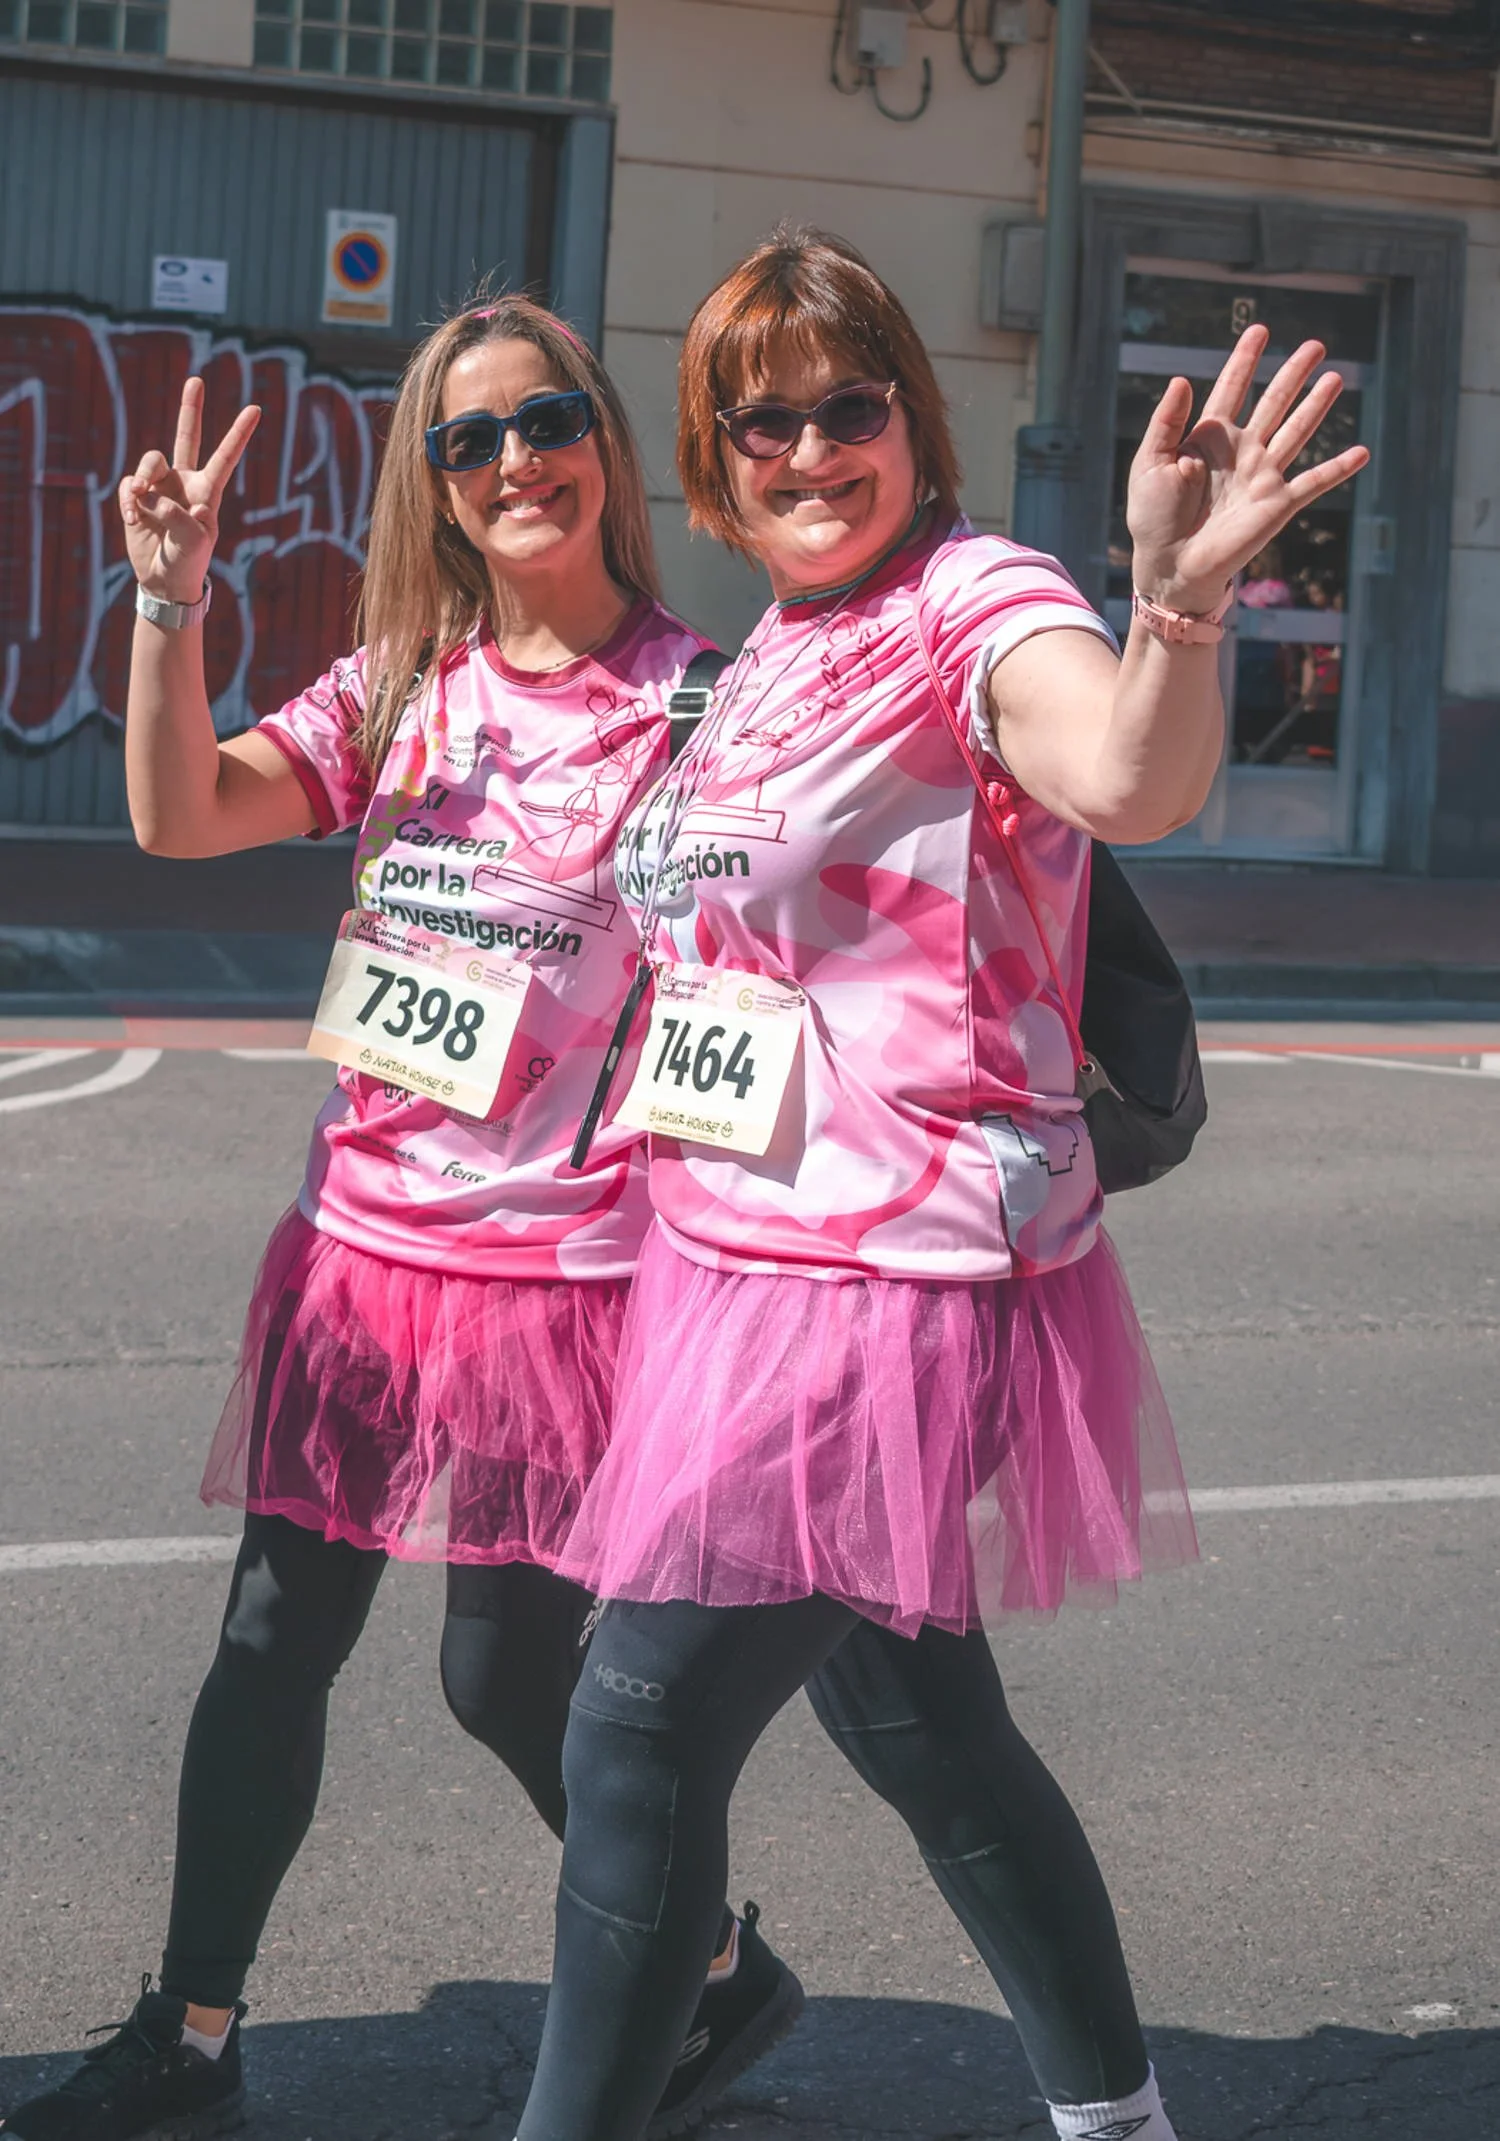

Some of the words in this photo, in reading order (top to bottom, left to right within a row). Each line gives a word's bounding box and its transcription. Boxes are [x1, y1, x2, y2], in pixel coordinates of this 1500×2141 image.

[418, 783, 451, 811] XI
[395, 818, 508, 859] Carrera
[379, 860, 432, 892] por
[438, 863, 466, 897] la
[358, 918, 372, 931] XI
[373, 926, 406, 944] Carrera
[406, 939, 422, 951] por
[422, 942, 431, 953] la
[356, 963, 485, 1062] 7398
[653, 1018, 755, 1100] 7464
